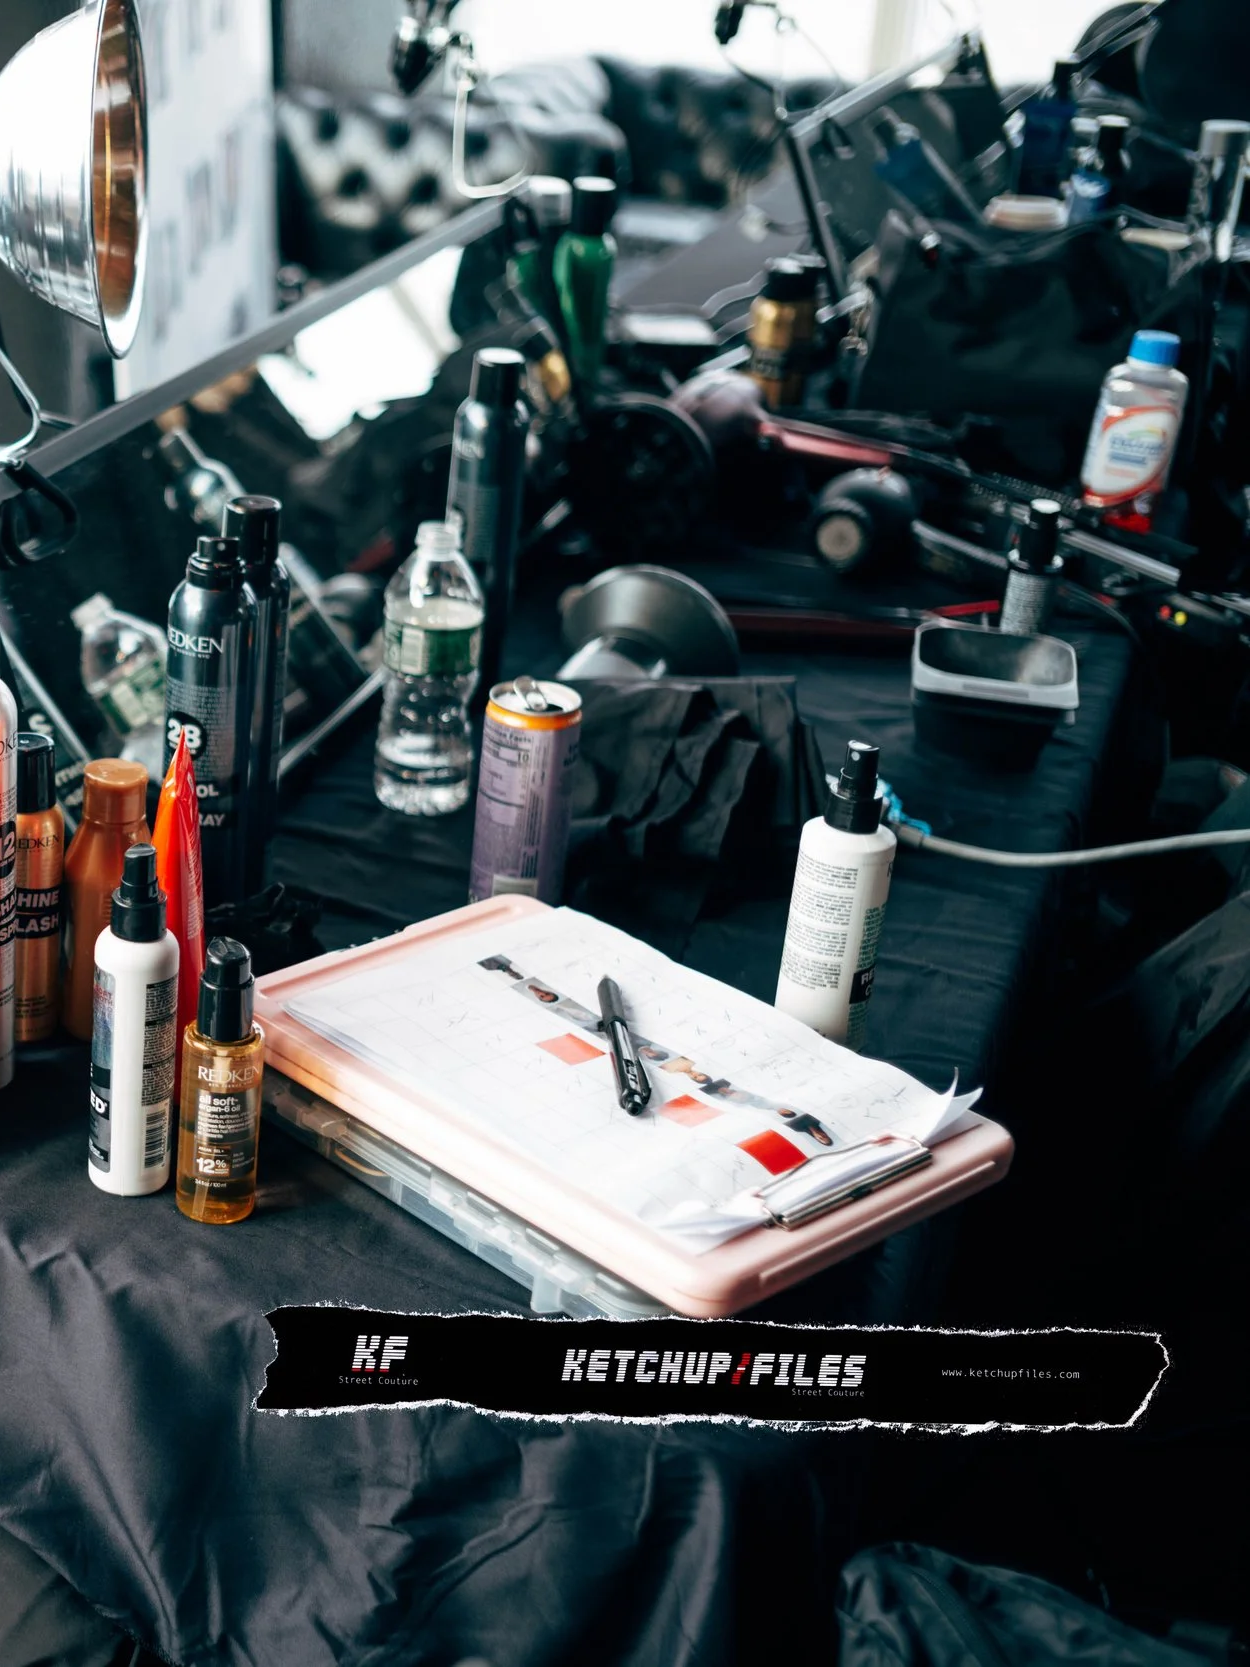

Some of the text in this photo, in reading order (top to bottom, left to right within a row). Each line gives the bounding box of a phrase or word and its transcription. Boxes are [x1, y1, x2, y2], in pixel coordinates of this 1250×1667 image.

[168, 624, 224, 654] EDKEN
[167, 717, 201, 750] 28
[517, 751, 530, 763] 10
[17, 834, 60, 850] EDKEN
[17, 890, 59, 908] HINE
[197, 1065, 260, 1083] REDKEN
